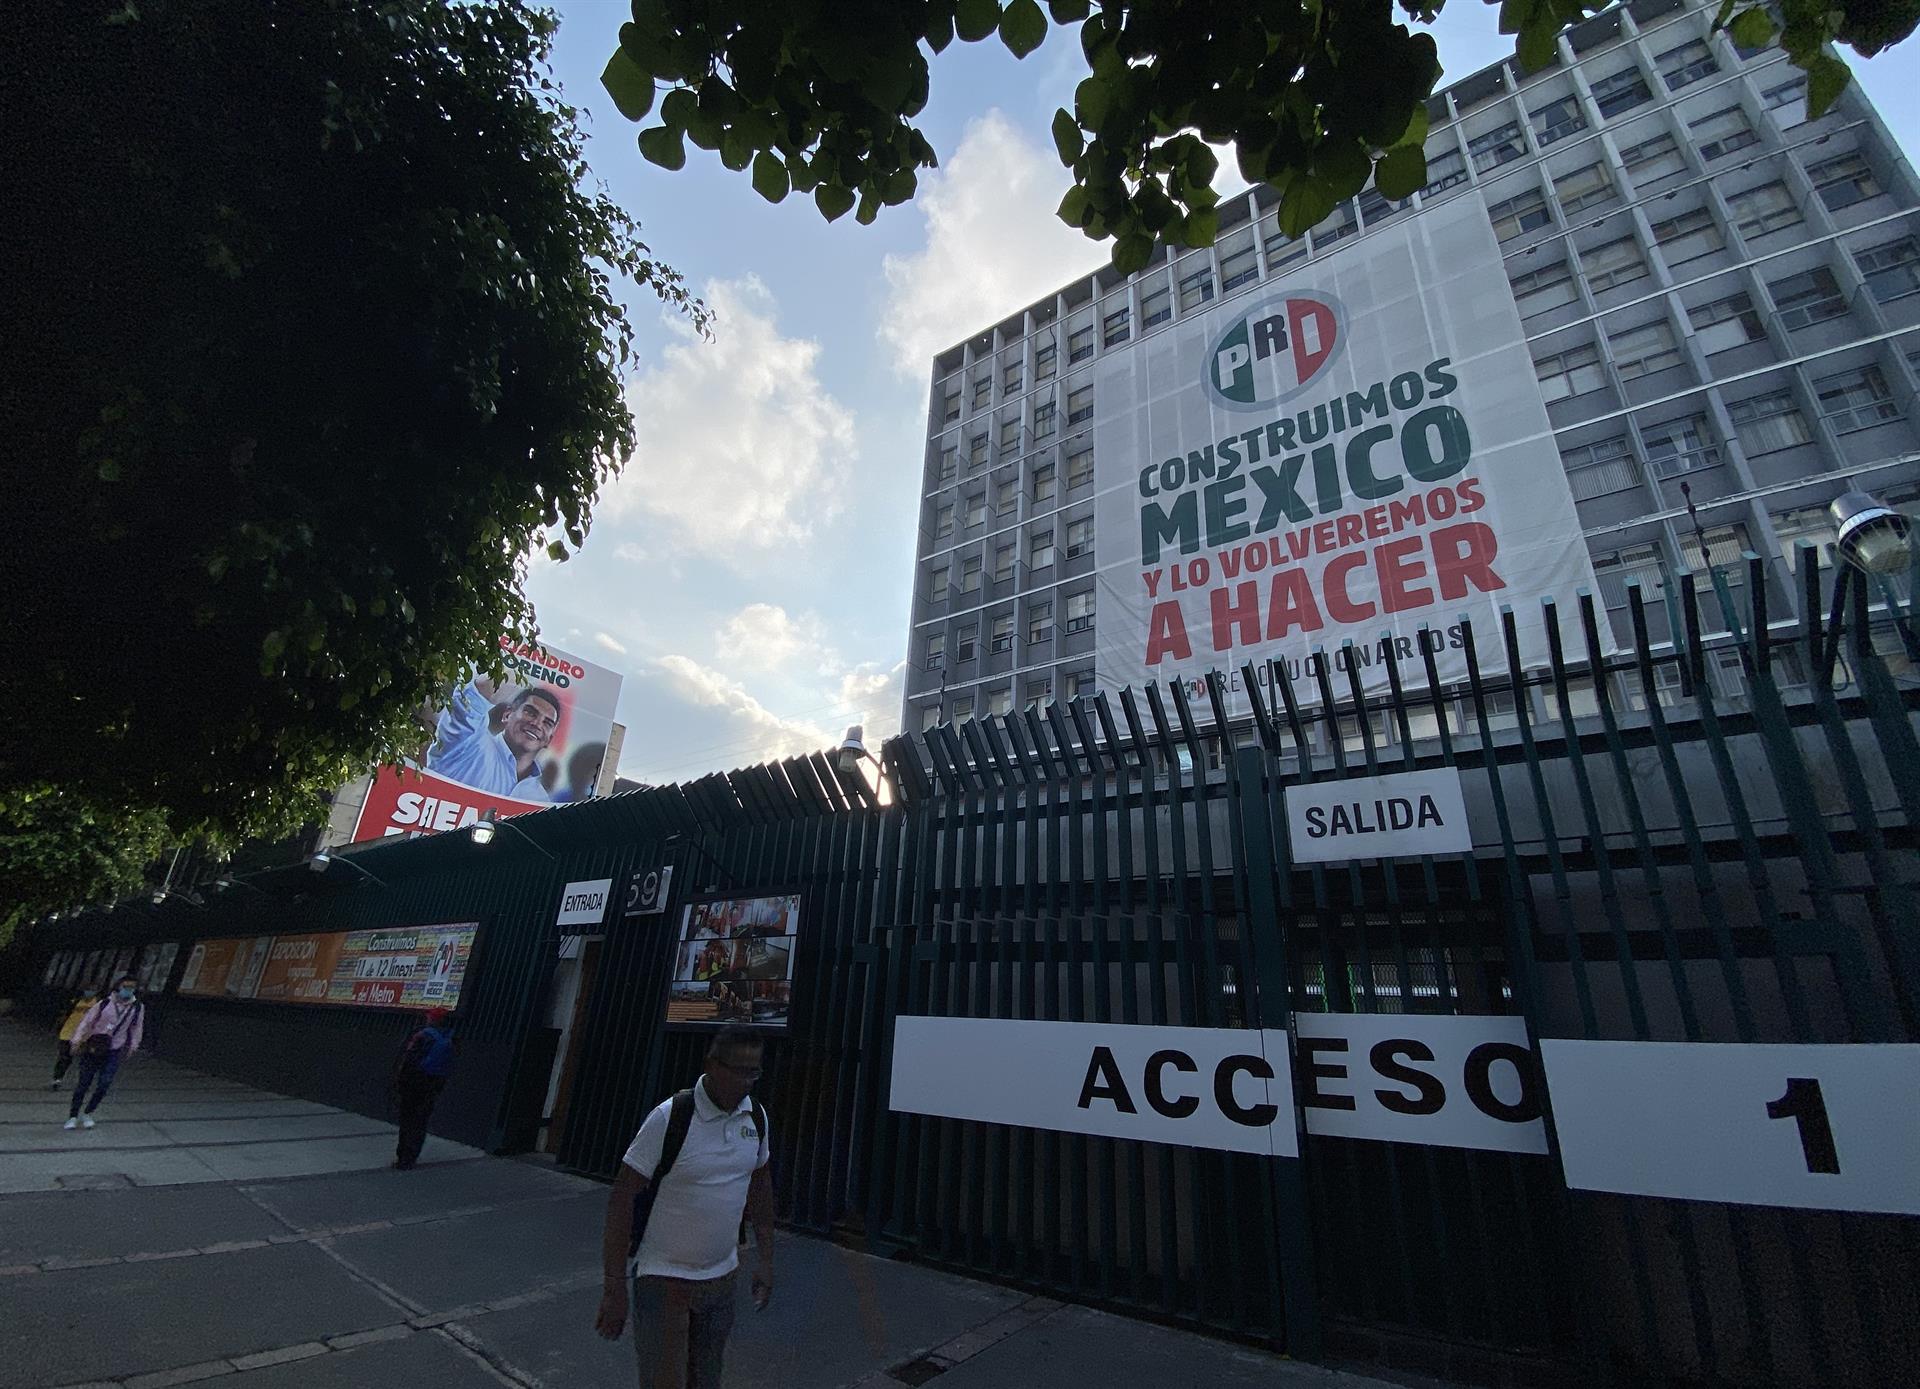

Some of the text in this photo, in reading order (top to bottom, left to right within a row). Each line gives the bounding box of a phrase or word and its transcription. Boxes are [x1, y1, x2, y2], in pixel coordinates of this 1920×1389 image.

[1218, 312, 1322, 390] PRI
[1140, 357, 1458, 498] CONSTRUIMOS
[1140, 405, 1472, 566] MÉXICO
[1142, 477, 1486, 598] Y LO VOLVEREMOS
[1145, 522, 1507, 666] A HACER
[502, 654, 570, 689] ORENO
[1305, 794, 1444, 838] SALIDA
[564, 893, 603, 912] ENTRADA
[358, 982, 395, 1004] del Metro
[376, 959, 389, 977] 12
[1077, 1037, 1841, 1176] ACCESO 1
